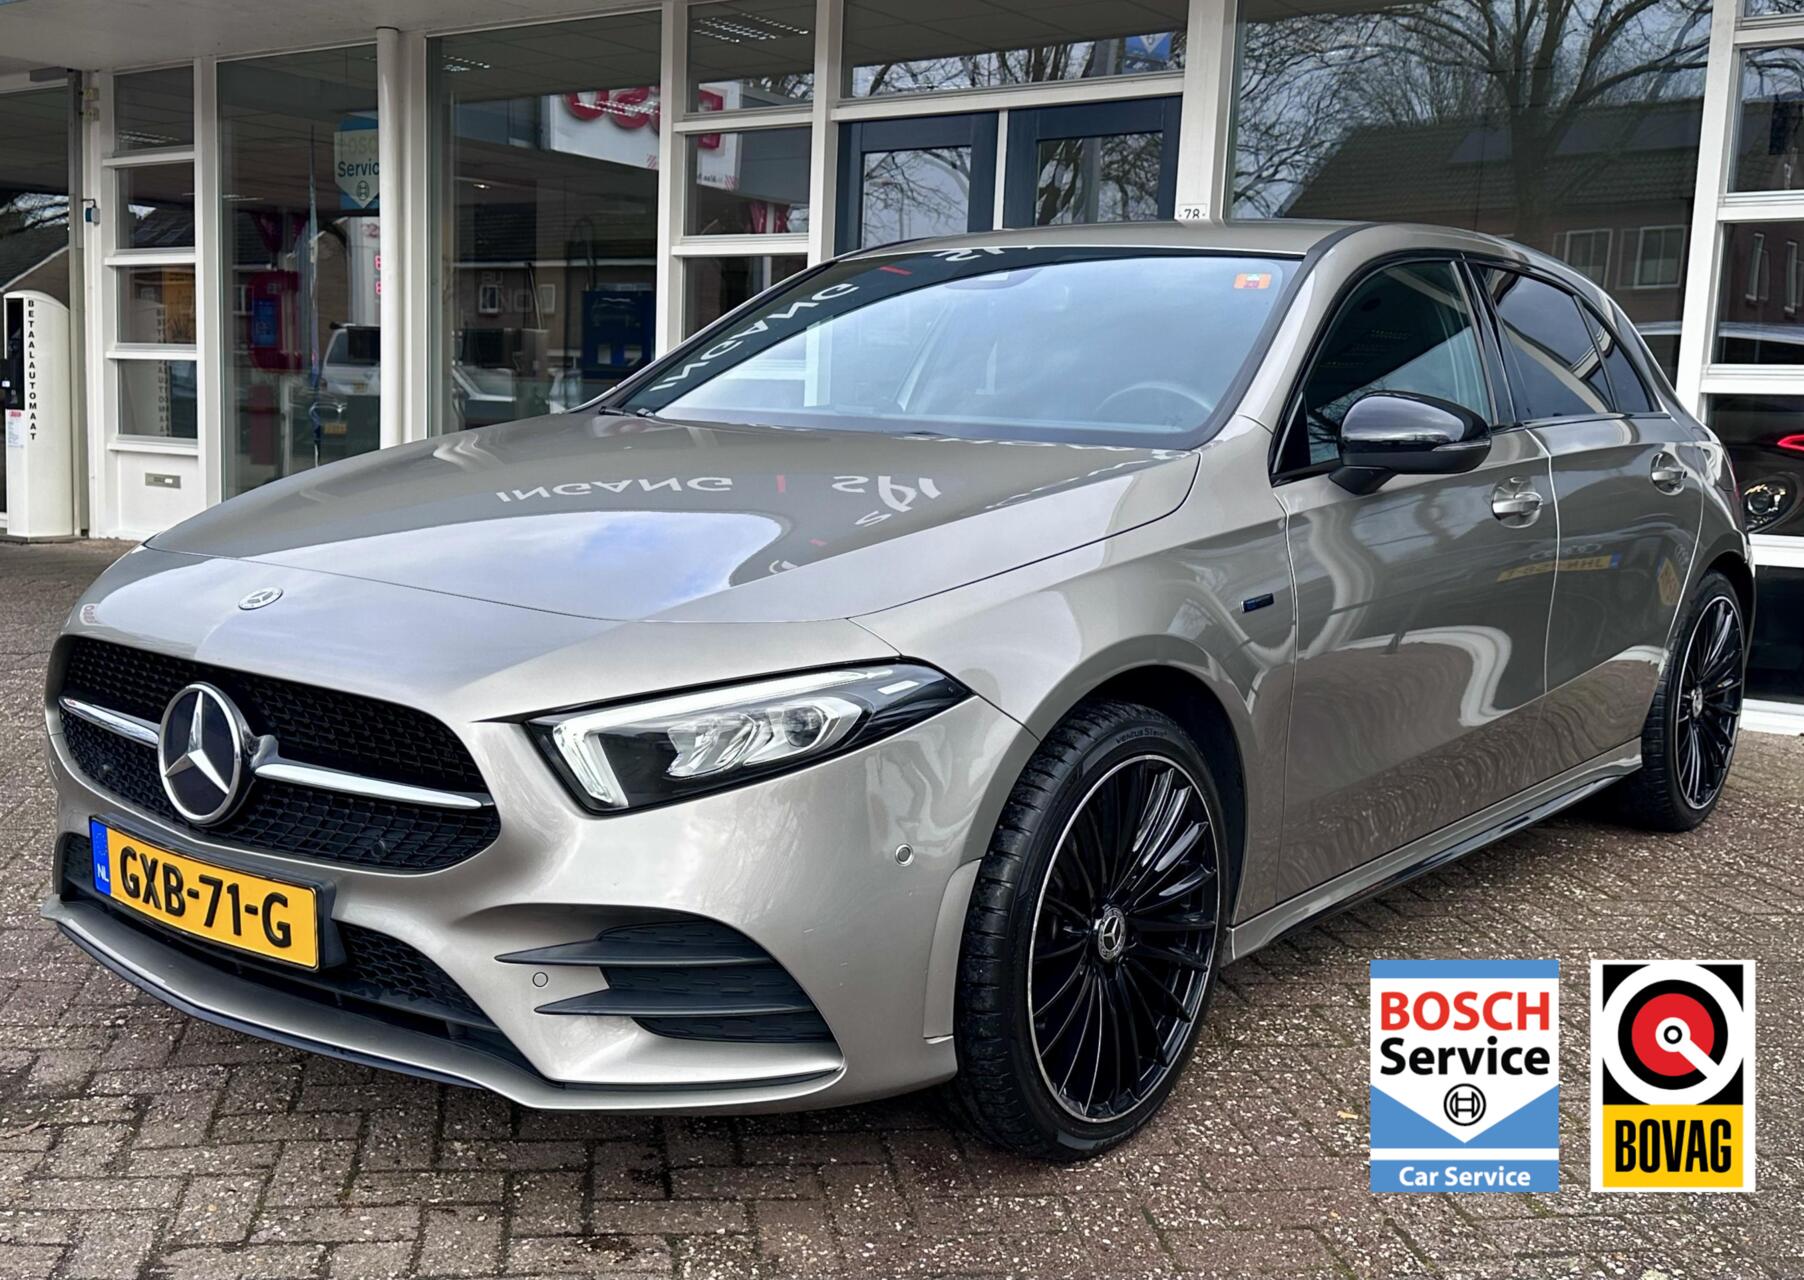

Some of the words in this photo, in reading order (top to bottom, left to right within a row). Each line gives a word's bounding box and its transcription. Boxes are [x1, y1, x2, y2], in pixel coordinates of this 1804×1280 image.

[1184, 208, 1200, 219] 78
[28, 300, 37, 440] BETAALAUTOMAAT
[97, 864, 109, 883] NL
[120, 846, 292, 948] GXB-71-G
